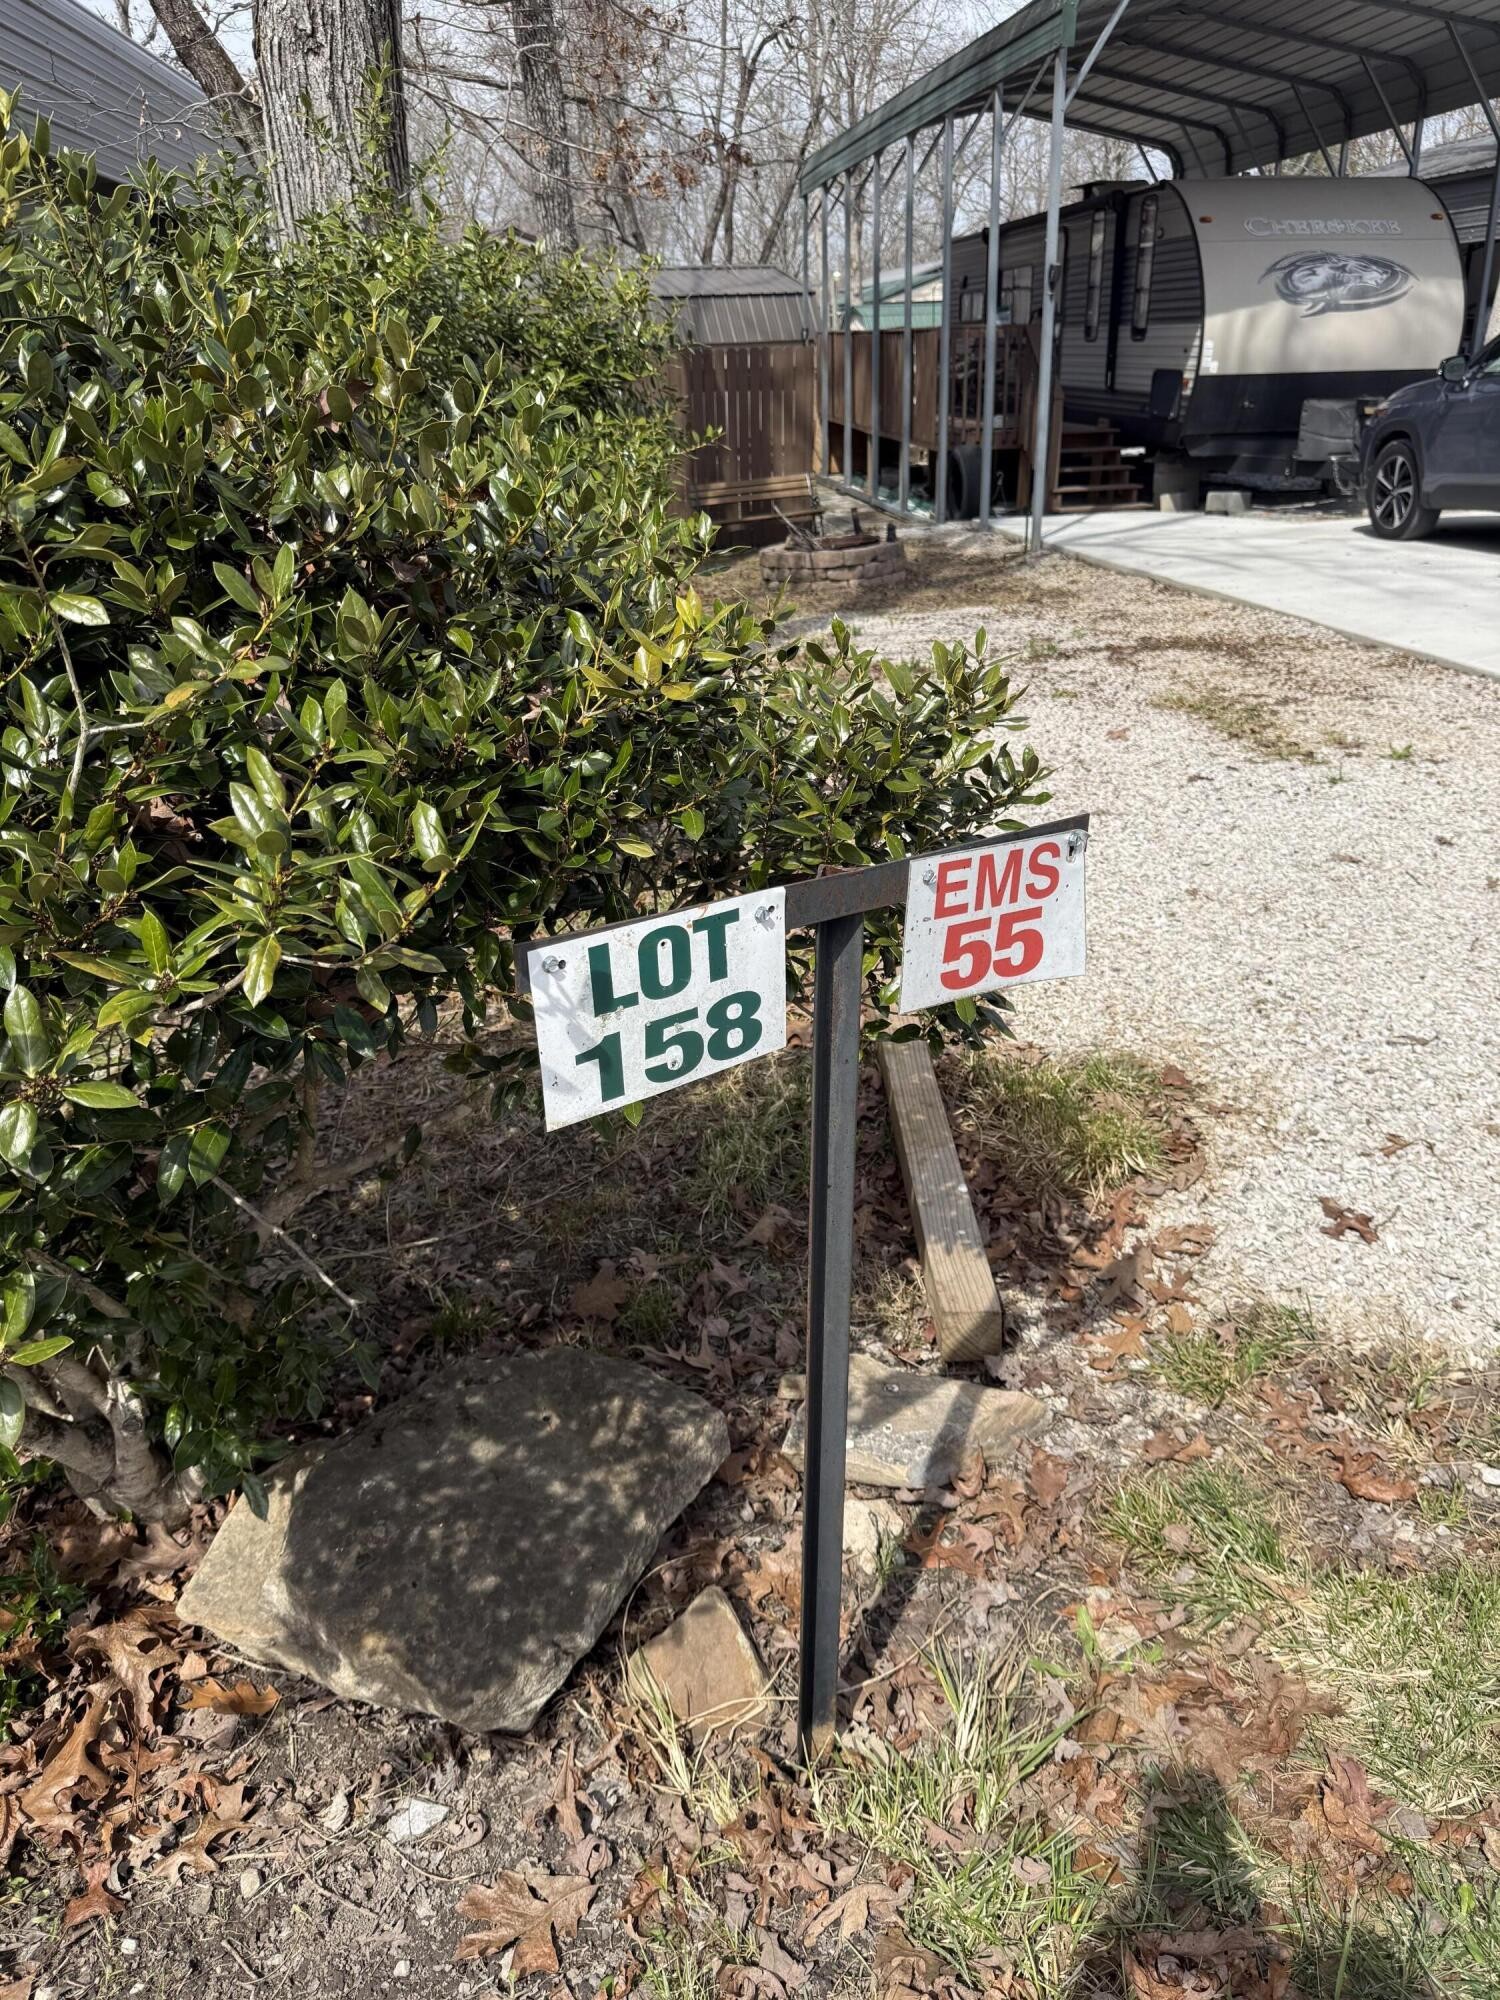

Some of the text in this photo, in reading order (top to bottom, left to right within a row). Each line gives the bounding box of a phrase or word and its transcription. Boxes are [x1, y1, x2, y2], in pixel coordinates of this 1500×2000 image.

[933, 842, 1060, 919] EMS
[588, 908, 739, 1018] LOT
[940, 907, 1043, 990] 55
[575, 991, 762, 1102] 158
